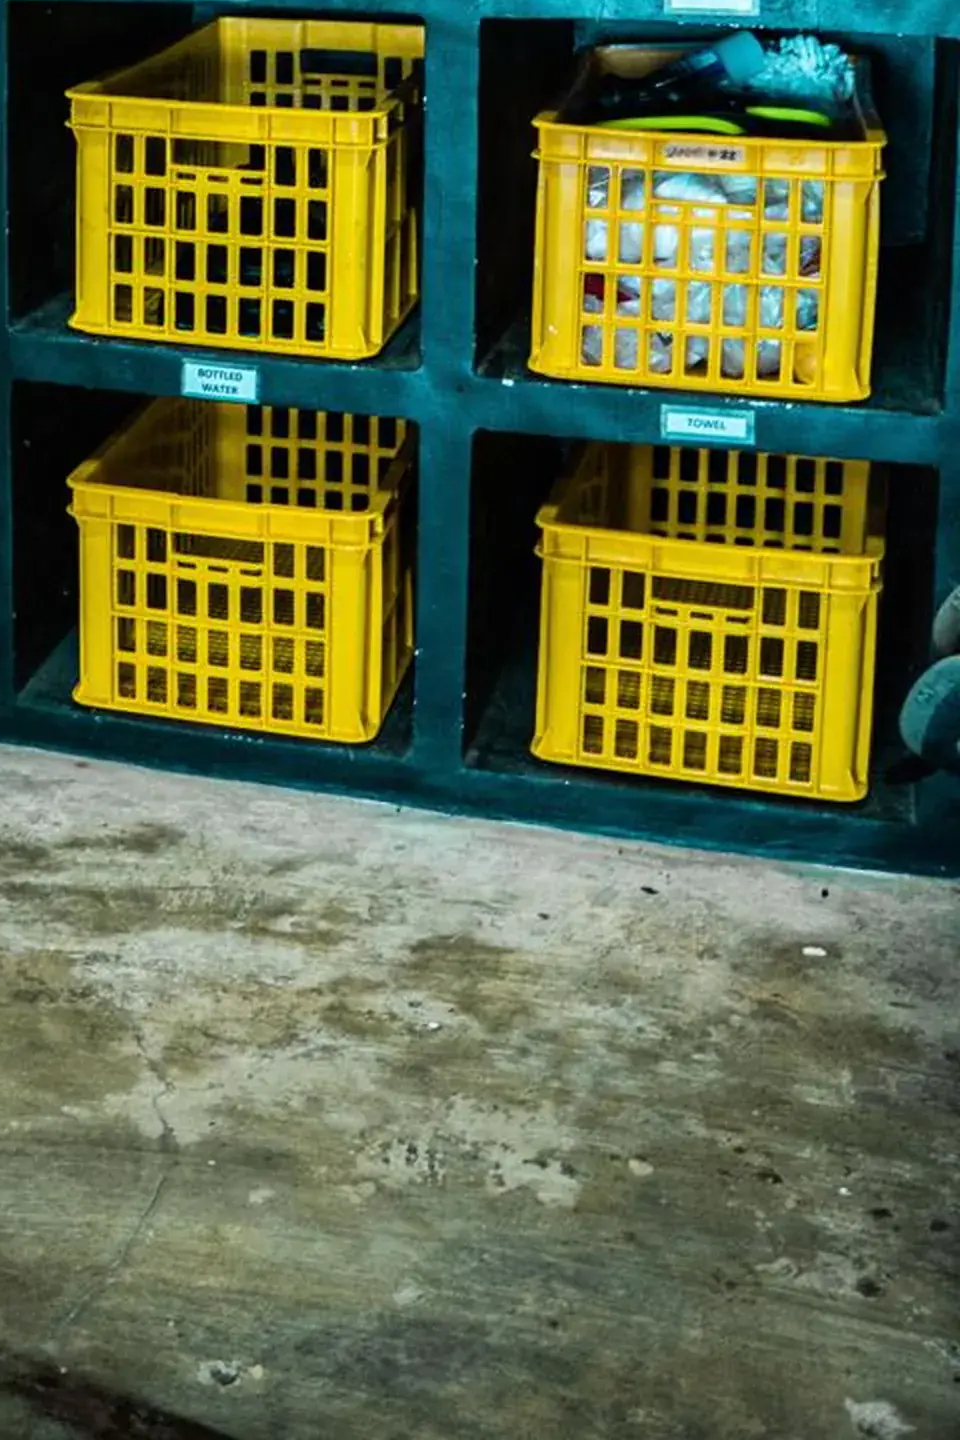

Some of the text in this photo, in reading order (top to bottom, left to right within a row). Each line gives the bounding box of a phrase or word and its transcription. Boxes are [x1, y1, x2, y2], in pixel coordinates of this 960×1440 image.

[198, 368, 243, 382] BOTTLED
[201, 383, 238, 395] WATER
[687, 417, 727, 431] TOWEL
